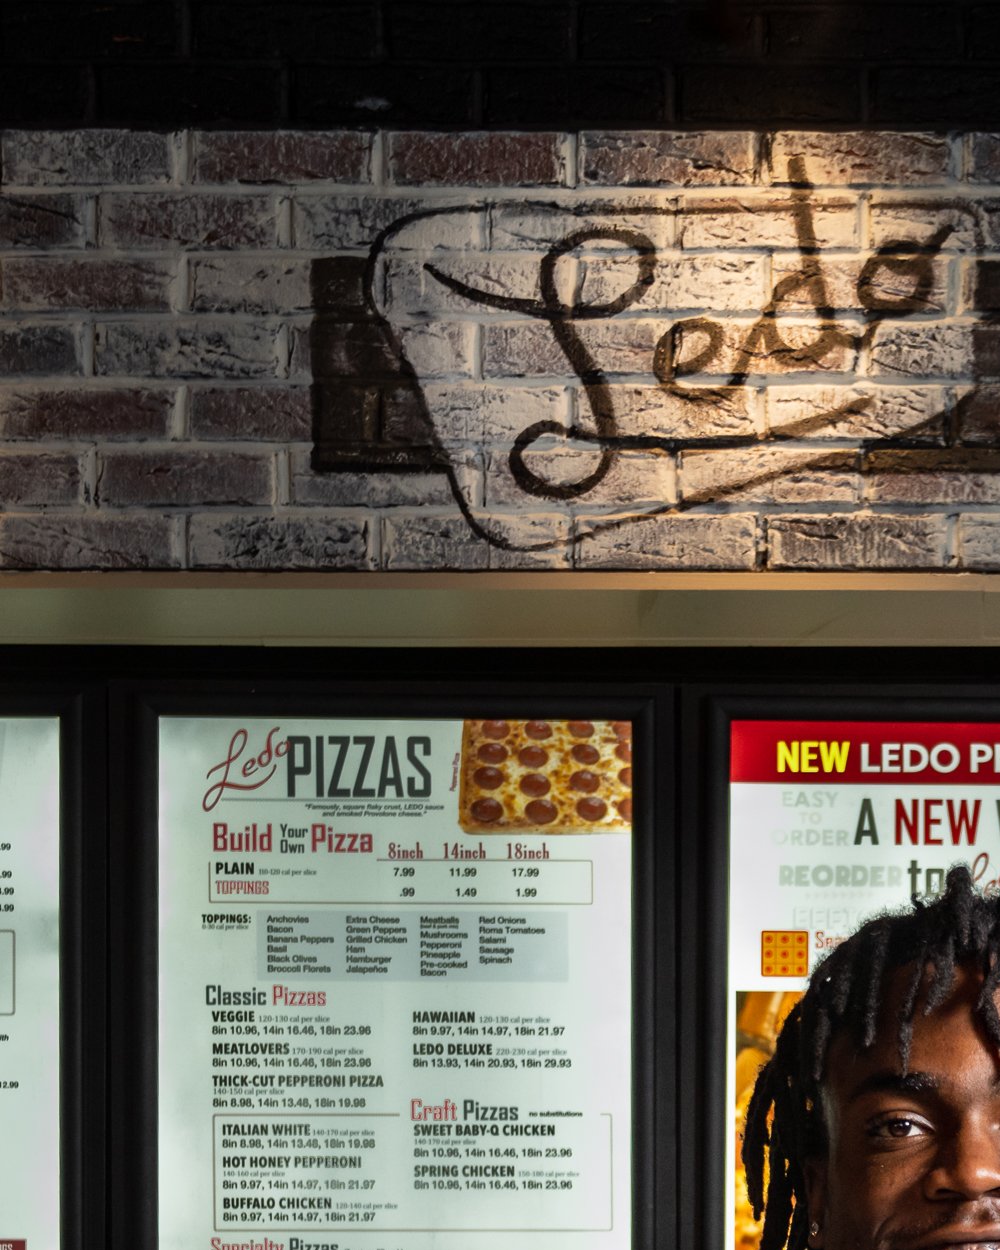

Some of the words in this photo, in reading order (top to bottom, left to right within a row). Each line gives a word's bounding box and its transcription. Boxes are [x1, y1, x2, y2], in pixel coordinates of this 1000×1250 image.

[421, 155, 957, 500] Ledo
[776, 740, 851, 774] NEW
[860, 742, 961, 774] LEDO
[202, 726, 291, 812] Ledo
[286, 735, 432, 798] PIZZAS
[782, 791, 839, 808] EASY
[853, 797, 880, 846] A
[894, 798, 982, 846] NEW
[280, 823, 309, 838] Your
[212, 822, 273, 853] Build
[311, 823, 374, 853] Pizza
[771, 828, 849, 847] ORDER
[279, 839, 305, 854] Own
[388, 841, 424, 859] 8inch
[443, 842, 487, 860] 14inch
[506, 842, 550, 860] 18inch
[215, 862, 255, 875] PLAIN
[393, 867, 415, 877] 7.99
[449, 867, 478, 877] 11.99
[512, 868, 540, 877] 17.99
[778, 864, 904, 888] REORDER
[215, 880, 270, 895] TOPPINGS
[399, 887, 415, 897] .99
[455, 888, 478, 897] 1.49
[515, 888, 538, 897] 1.99
[201, 914, 252, 924] TOPPINGS:
[267, 915, 309, 924] Anchovies
[267, 925, 294, 934] Bacon
[420, 931, 469, 940] Mushrooms
[420, 941, 462, 950] Pepperoni
[420, 951, 461, 960] Pineapple
[205, 984, 267, 1006] Classic
[272, 984, 327, 1006] Pizzas
[211, 1010, 256, 1023] VEGGIE
[412, 1011, 476, 1024] HAWAIIAN
[412, 1026, 428, 1036] 8in
[457, 1026, 479, 1036] 14in
[514, 1026, 536, 1036] 18in
[212, 1042, 290, 1055] MEATLOVERS
[412, 1043, 445, 1056] LEDO
[447, 1043, 493, 1056] DELUXE
[212, 1075, 275, 1088] THICK-CUT
[277, 1075, 346, 1088] PEPPERONI
[349, 1075, 385, 1088] PIZZA
[410, 1098, 458, 1121] Craft
[462, 1099, 519, 1121] Pizzas
[222, 1124, 269, 1136] ITALIAN
[271, 1124, 311, 1136] WHITE
[413, 1124, 453, 1137] SWEET
[455, 1124, 500, 1137] BABY-Q
[502, 1124, 556, 1137] CHICKEN
[222, 1156, 247, 1169] HOT
[249, 1156, 291, 1169] HONEY
[294, 1156, 362, 1169] PEPPERONI
[222, 1197, 276, 1210] BUFFALO
[278, 1197, 332, 1210] CHICKEN
